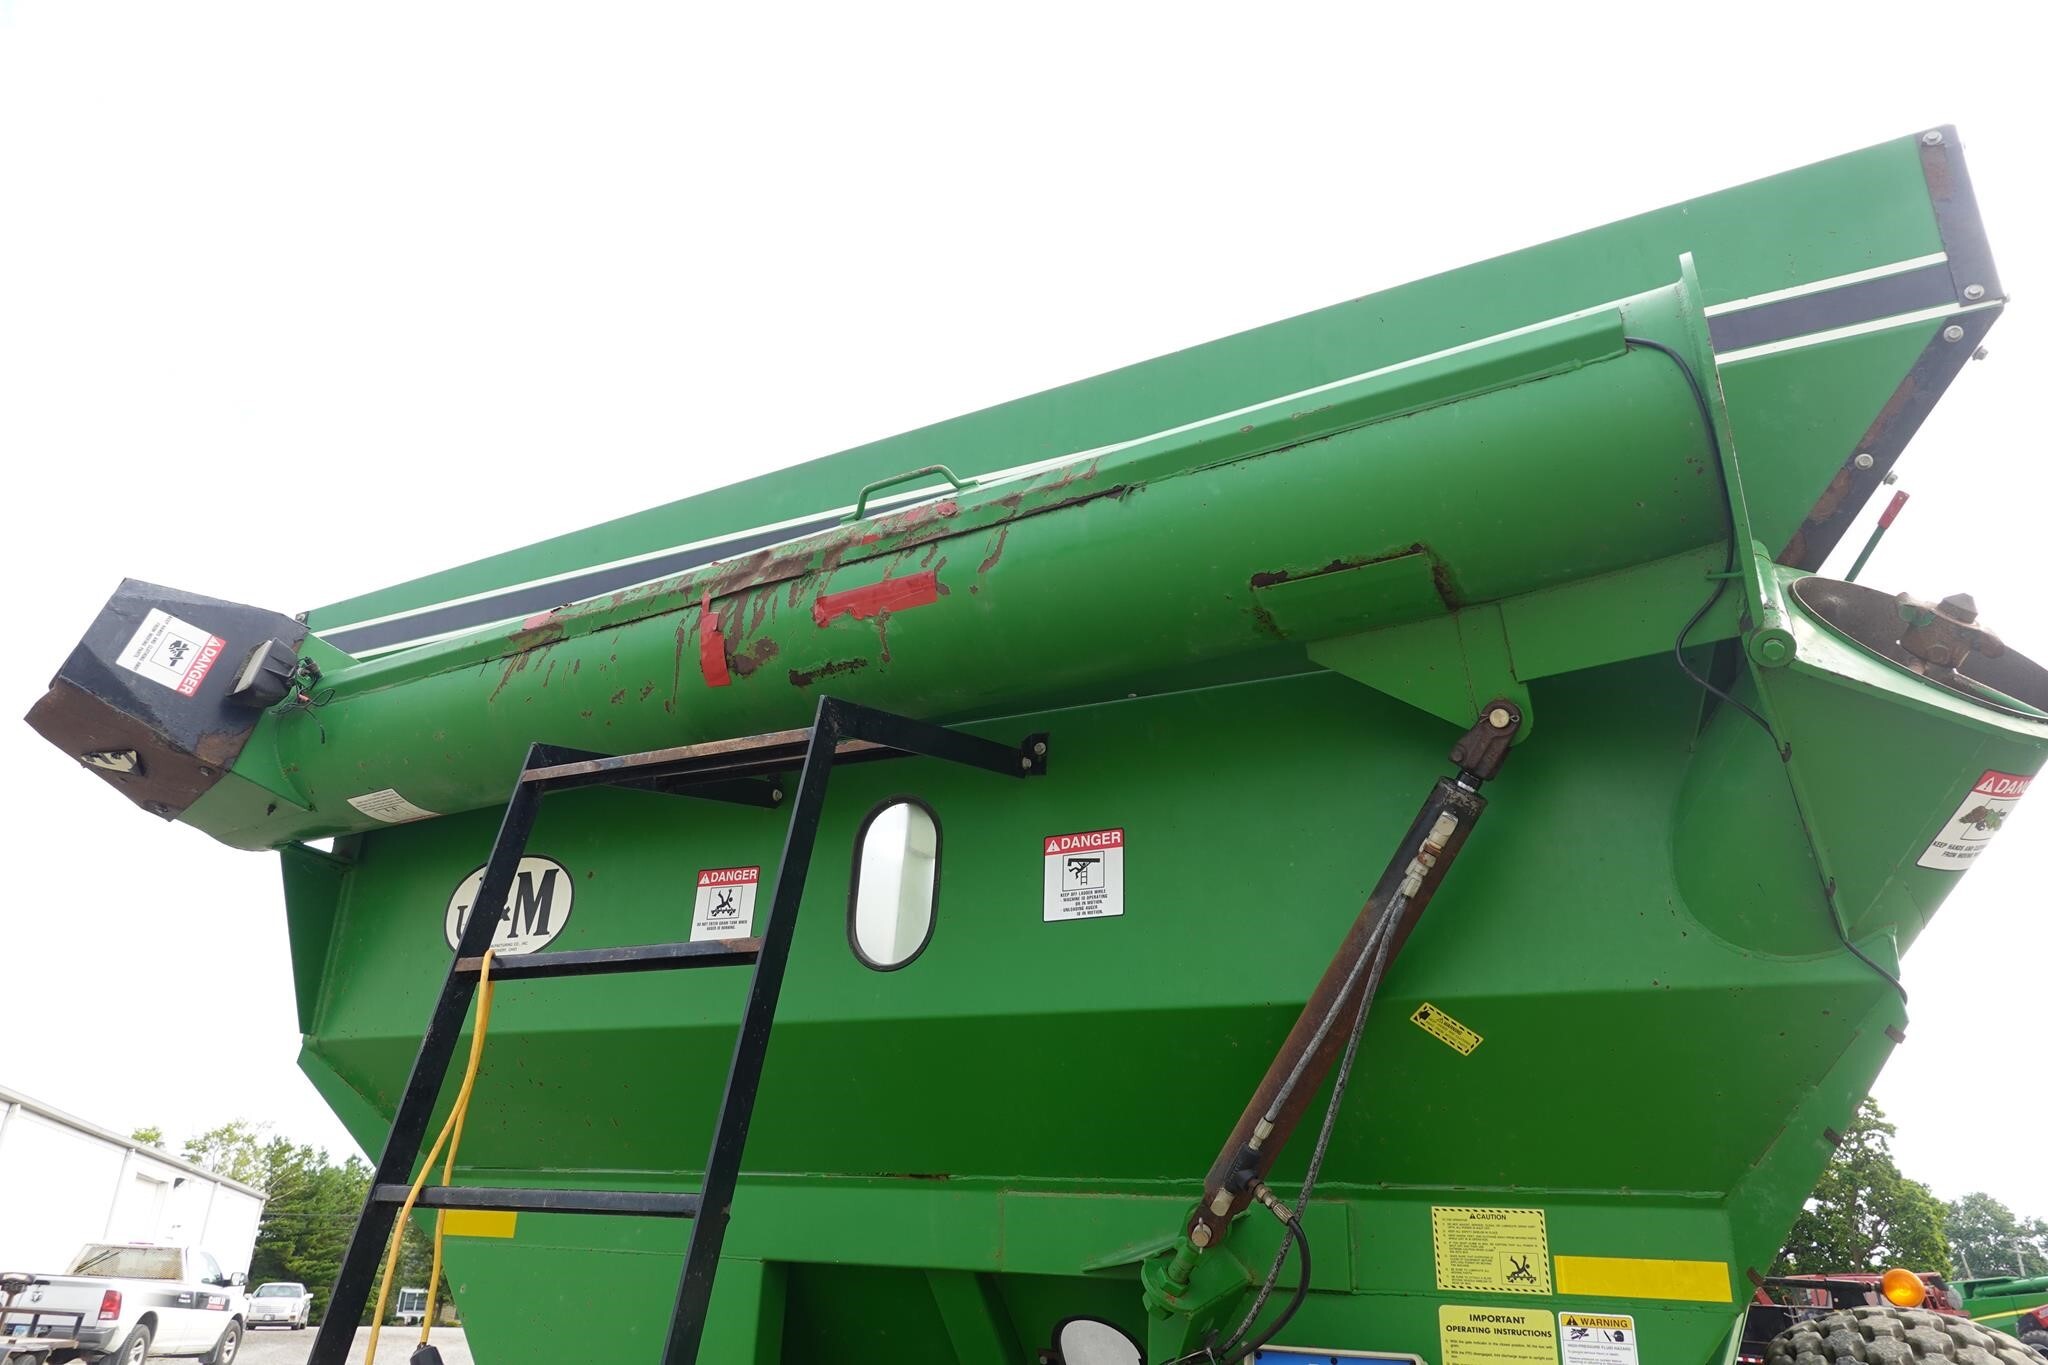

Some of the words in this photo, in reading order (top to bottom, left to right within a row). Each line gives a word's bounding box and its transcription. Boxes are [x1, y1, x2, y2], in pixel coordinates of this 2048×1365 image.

[179, 648, 218, 696] DANGER
[1061, 831, 1121, 849] DANGER
[1932, 840, 1948, 848] KEEP
[711, 869, 758, 883] DANGER
[1469, 1314, 1526, 1325] IMPORTANT
[1580, 1317, 1628, 1328] WARNING
[1446, 1325, 1491, 1334] OPERATING
[1493, 1327, 1553, 1338] INSTRUCTIONS
